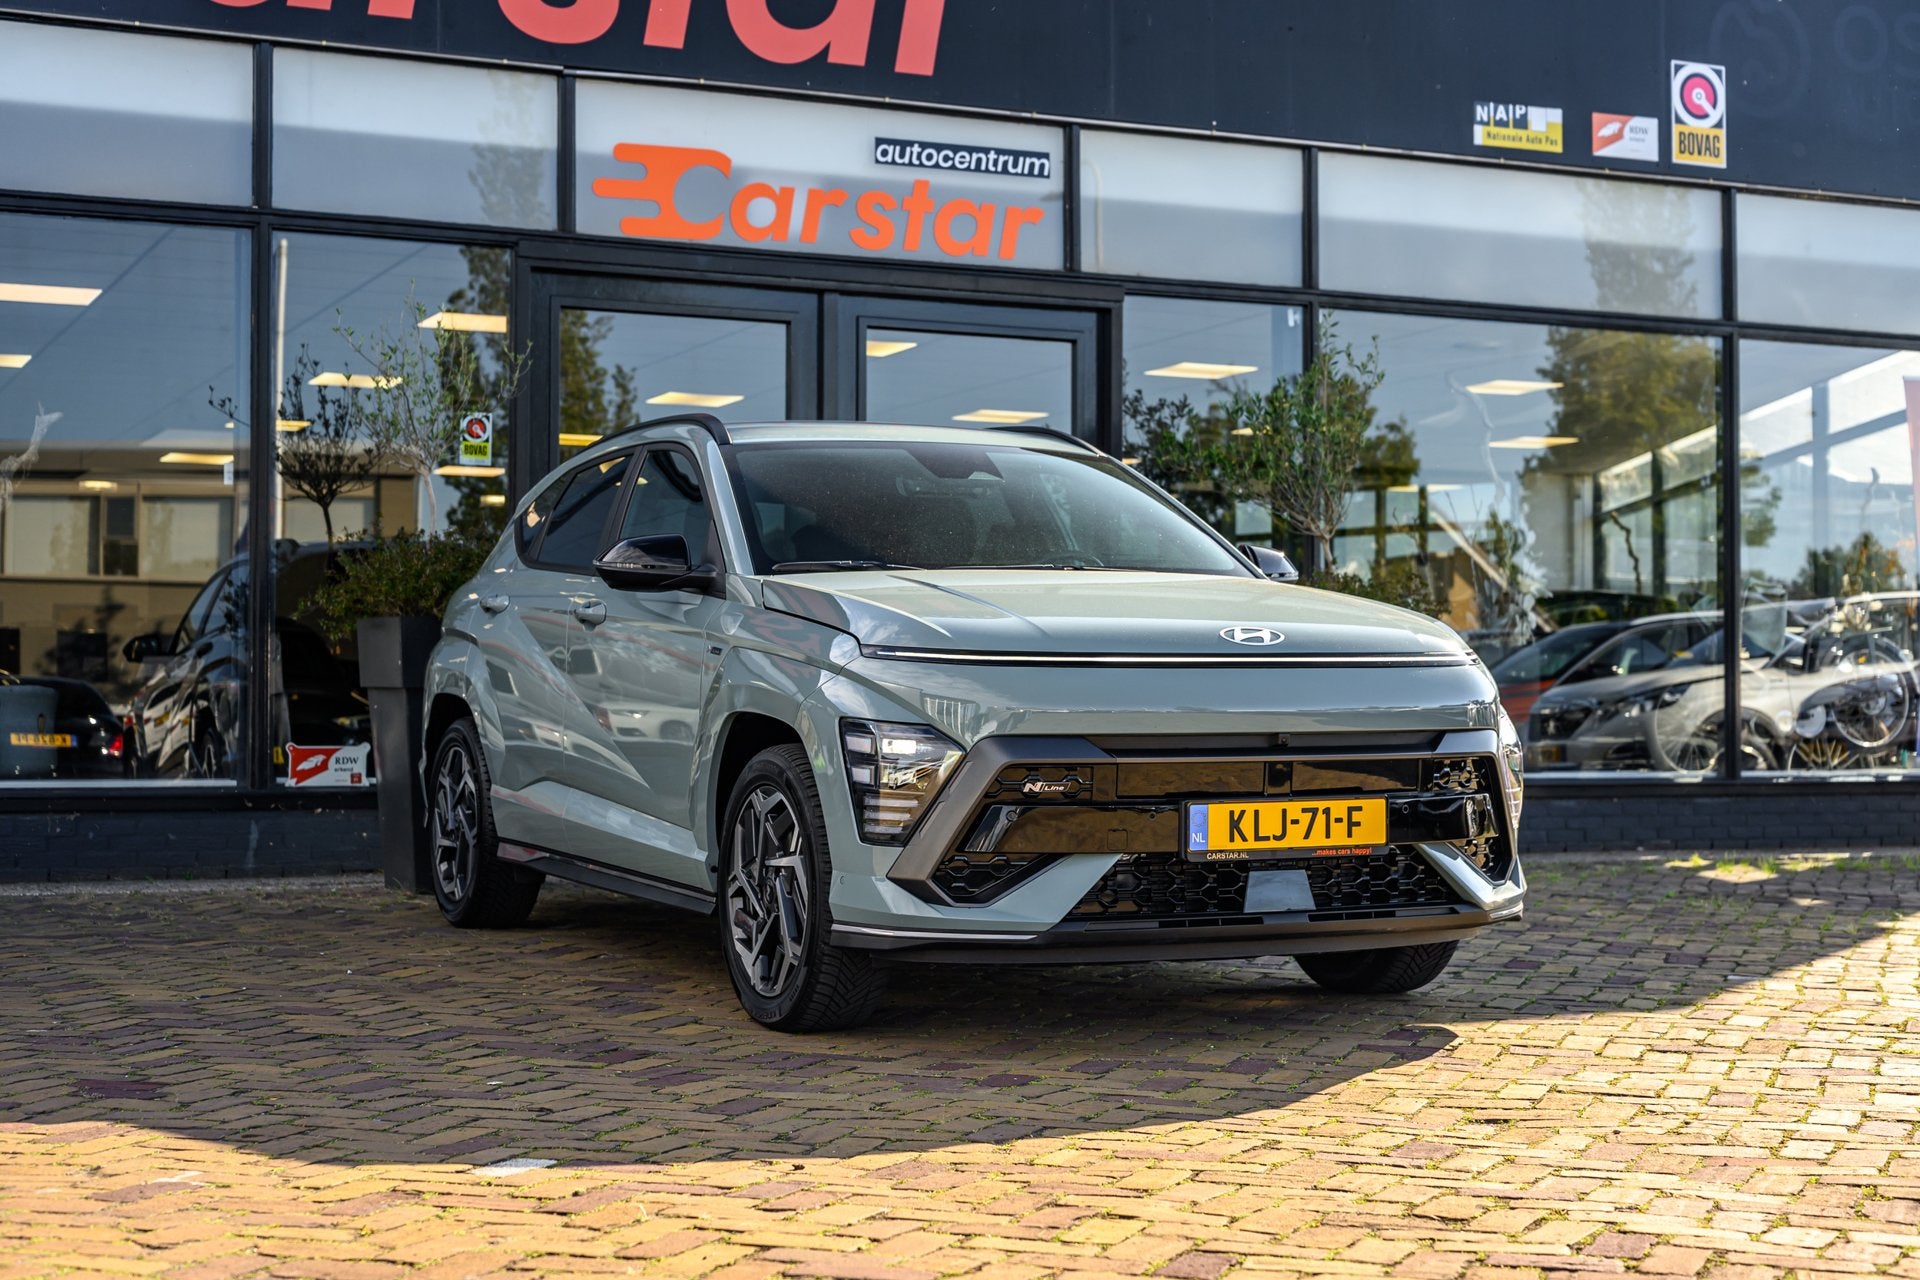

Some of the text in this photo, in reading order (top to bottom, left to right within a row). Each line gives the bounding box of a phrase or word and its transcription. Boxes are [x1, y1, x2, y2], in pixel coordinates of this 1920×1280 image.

[1476, 103, 1526, 123] NAP
[1486, 130, 1558, 146] Nationale Auto Pas
[1678, 131, 1720, 158] BOVAG
[875, 140, 1050, 177] autocentrum
[592, 142, 1045, 261] Carstar
[464, 443, 488, 457] BOVAG
[334, 756, 360, 765] RDW
[1228, 805, 1364, 844] KLJ-71-F
[1191, 832, 1206, 844] NL
[1206, 851, 1249, 860] CARSTAR.NL
[1352, 847, 1373, 856] happy!
